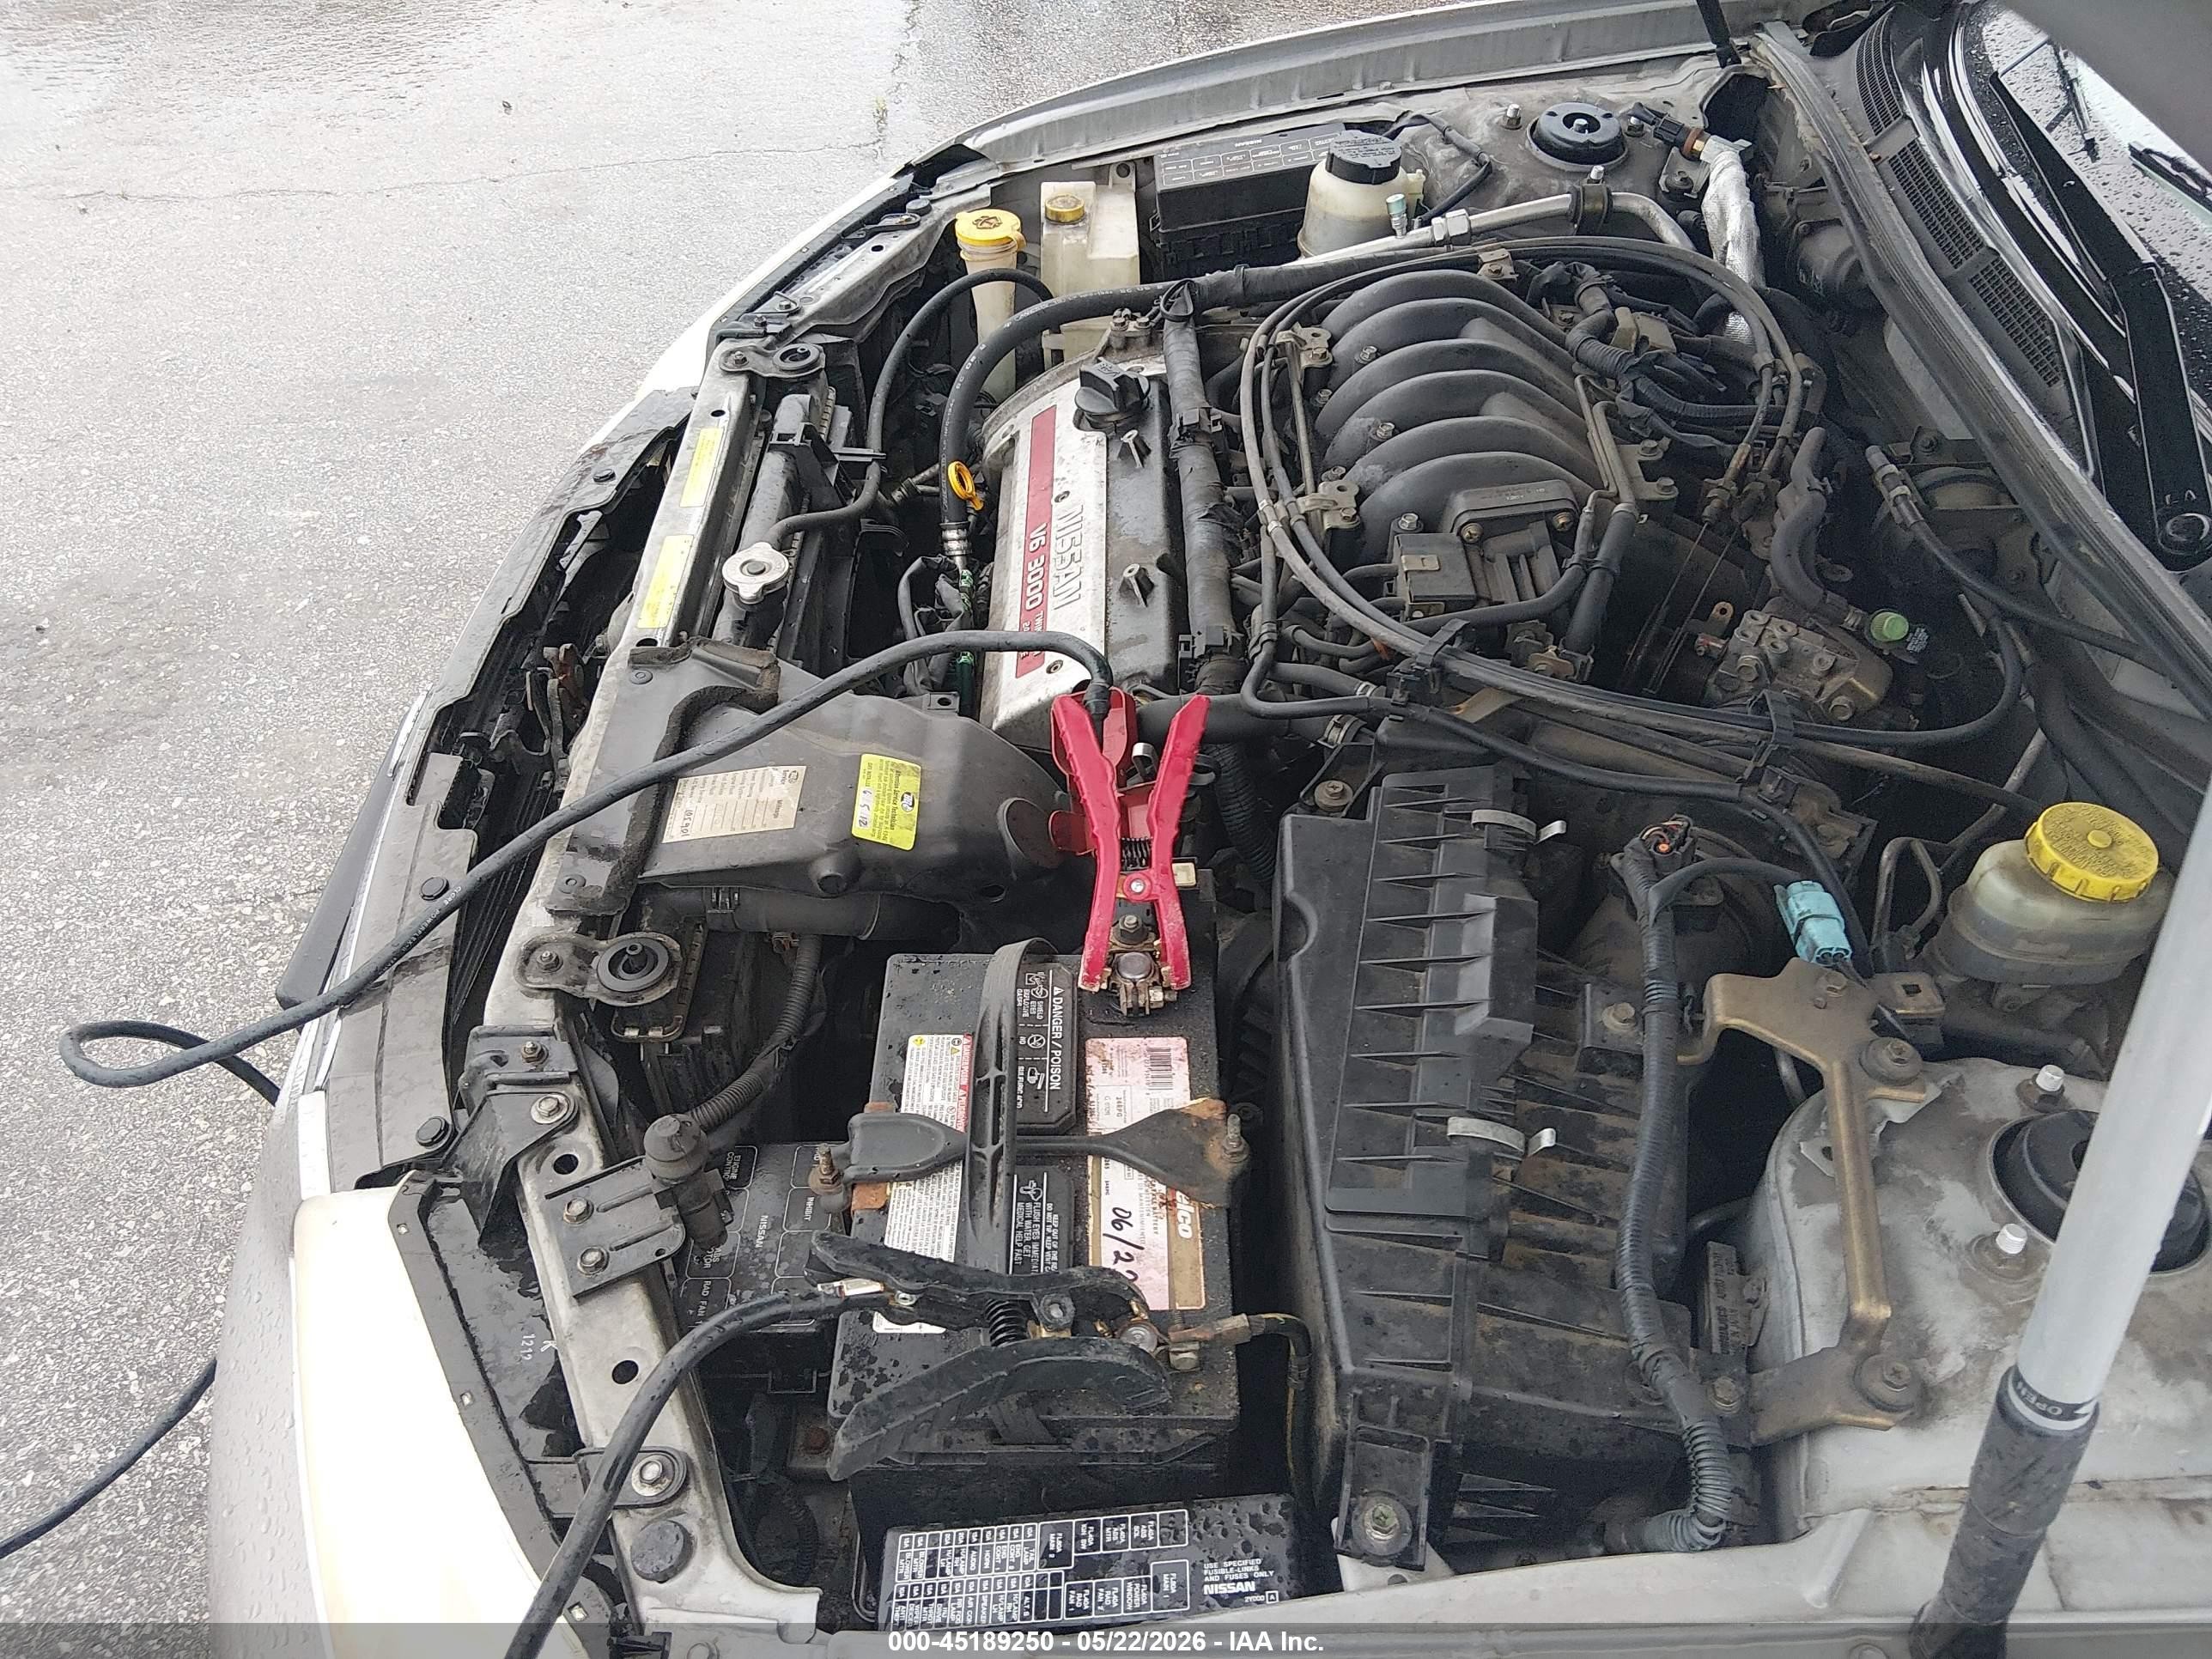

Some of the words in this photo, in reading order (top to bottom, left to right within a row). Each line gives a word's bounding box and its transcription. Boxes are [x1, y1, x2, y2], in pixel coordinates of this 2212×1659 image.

[1029, 522, 1047, 553] V6
[1053, 505, 1083, 611] NISSAN
[1025, 555, 1045, 611] 3000
[1051, 997, 1063, 1039] DANGER
[1049, 1050, 1061, 1090] POISON
[723, 1152, 734, 1181] CONTRO
[730, 1155, 741, 1180] ENGINE
[1016, 1202, 1024, 1229] MEDICAL
[755, 1215, 769, 1248] NISSAN
[702, 1247, 714, 1269] OTOR
[1030, 1243, 1039, 1274] IMMEDIAT
[702, 1281, 711, 1297] RAD
[697, 1301, 708, 1316] FAN
[1204, 1565, 1259, 1575] FUSIBLE-LINKS
[1224, 1559, 1262, 1567] SPECIFIED
[1204, 1581, 1255, 1595] NISSAN
